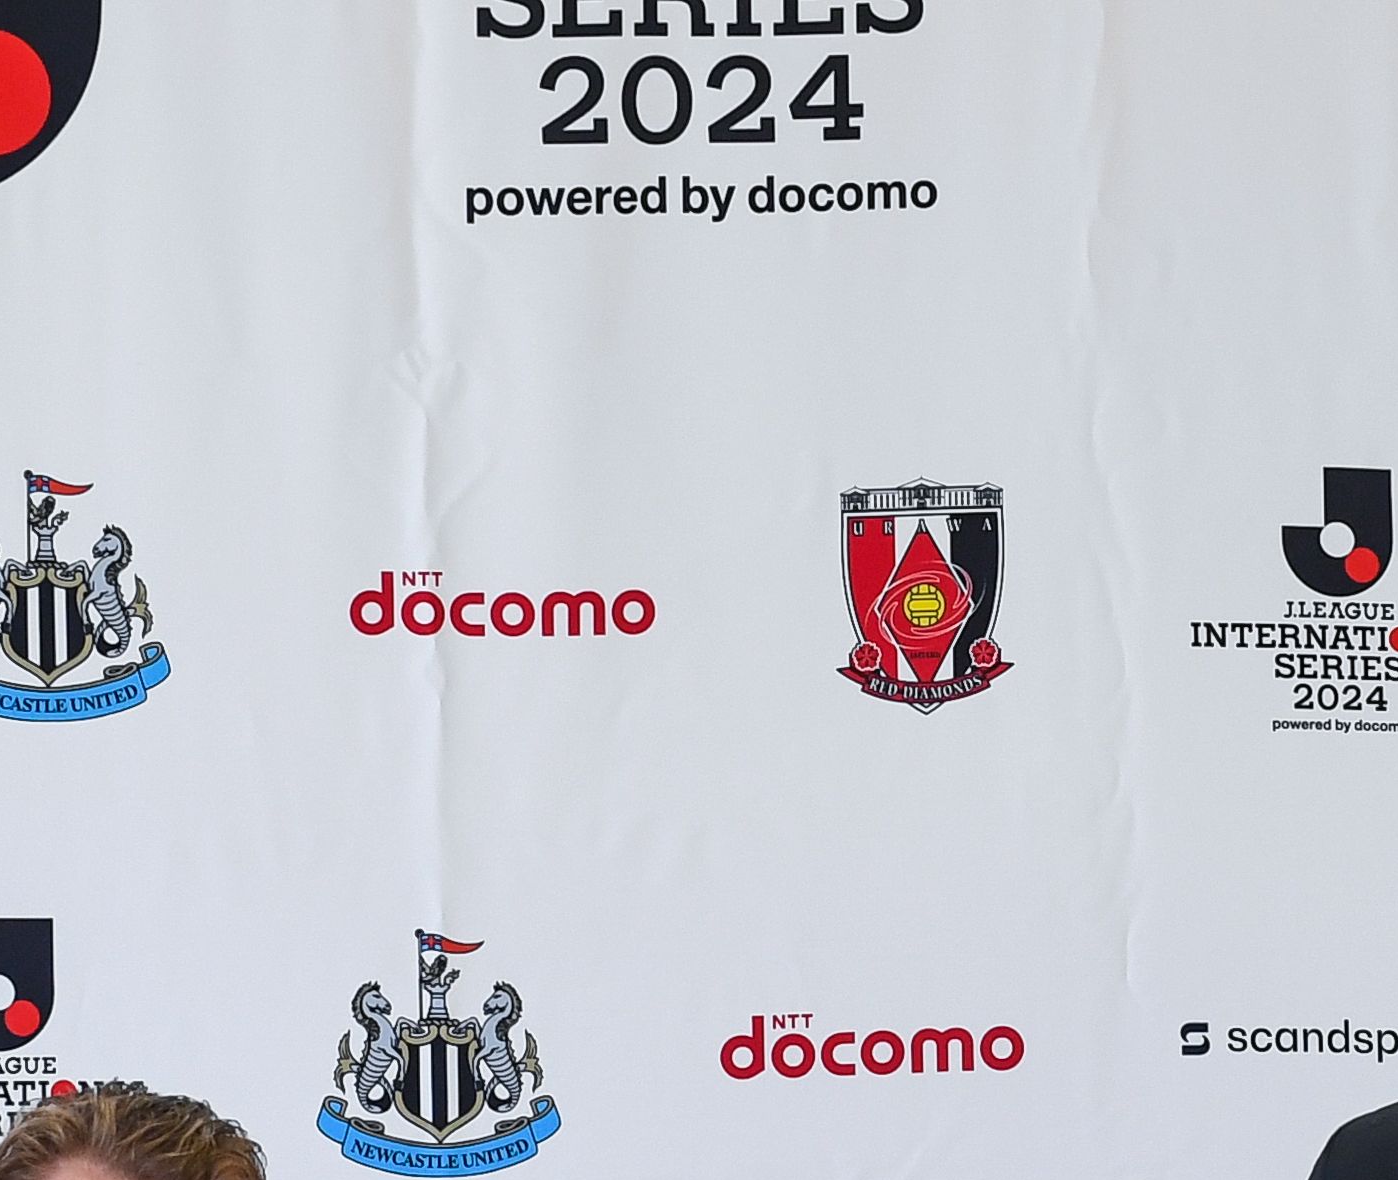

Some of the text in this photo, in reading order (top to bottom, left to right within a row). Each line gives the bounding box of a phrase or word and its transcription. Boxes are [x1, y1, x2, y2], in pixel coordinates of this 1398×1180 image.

[539, 53, 865, 145] 2024
[465, 176, 939, 224] powered by docomo
[402, 571, 443, 588] NTT
[349, 571, 657, 637] docomo
[1283, 600, 1395, 621] J.LEAGUE
[71, 684, 139, 713] UNITED
[868, 675, 984, 700] RED DIAMONDS
[1293, 683, 1388, 713] 2024
[1272, 718, 1332, 732] powered
[1335, 718, 1352, 734] by
[772, 1013, 814, 1030] NTT
[720, 1015, 1025, 1081] docomo
[351, 1137, 531, 1170] NEWCASTLE UNITED
